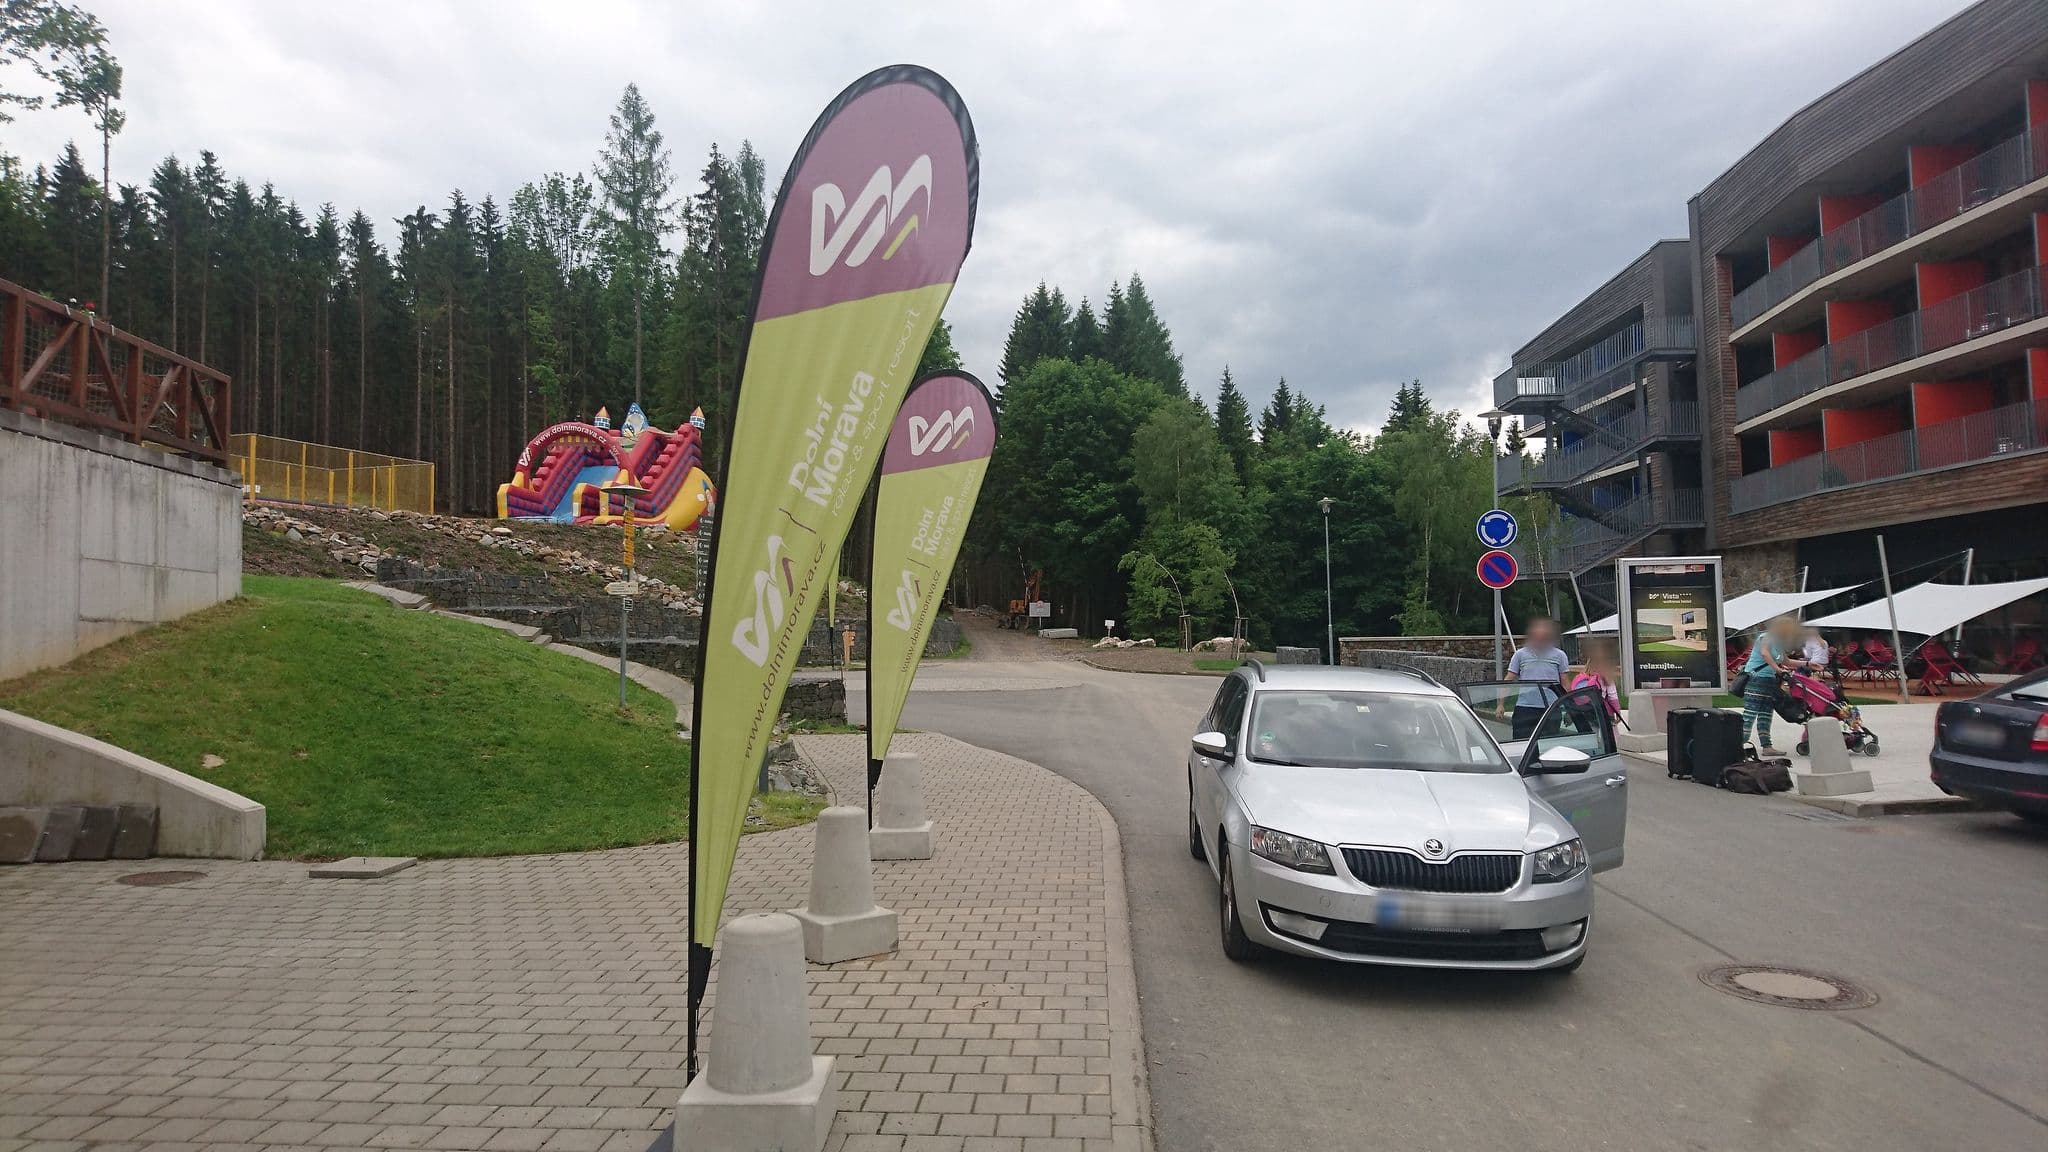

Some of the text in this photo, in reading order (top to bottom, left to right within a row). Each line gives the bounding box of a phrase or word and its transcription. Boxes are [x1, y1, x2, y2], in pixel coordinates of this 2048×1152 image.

[534, 424, 607, 446] www.dolnimorava.cz
[788, 393, 833, 493] Dolní
[804, 370, 875, 507] Morava
[831, 309, 921, 517] relax & sport resort
[923, 495, 954, 556] Morava
[745, 540, 827, 759] www.dolnimorava.cz
[1639, 662, 1683, 670] relaxujte...
